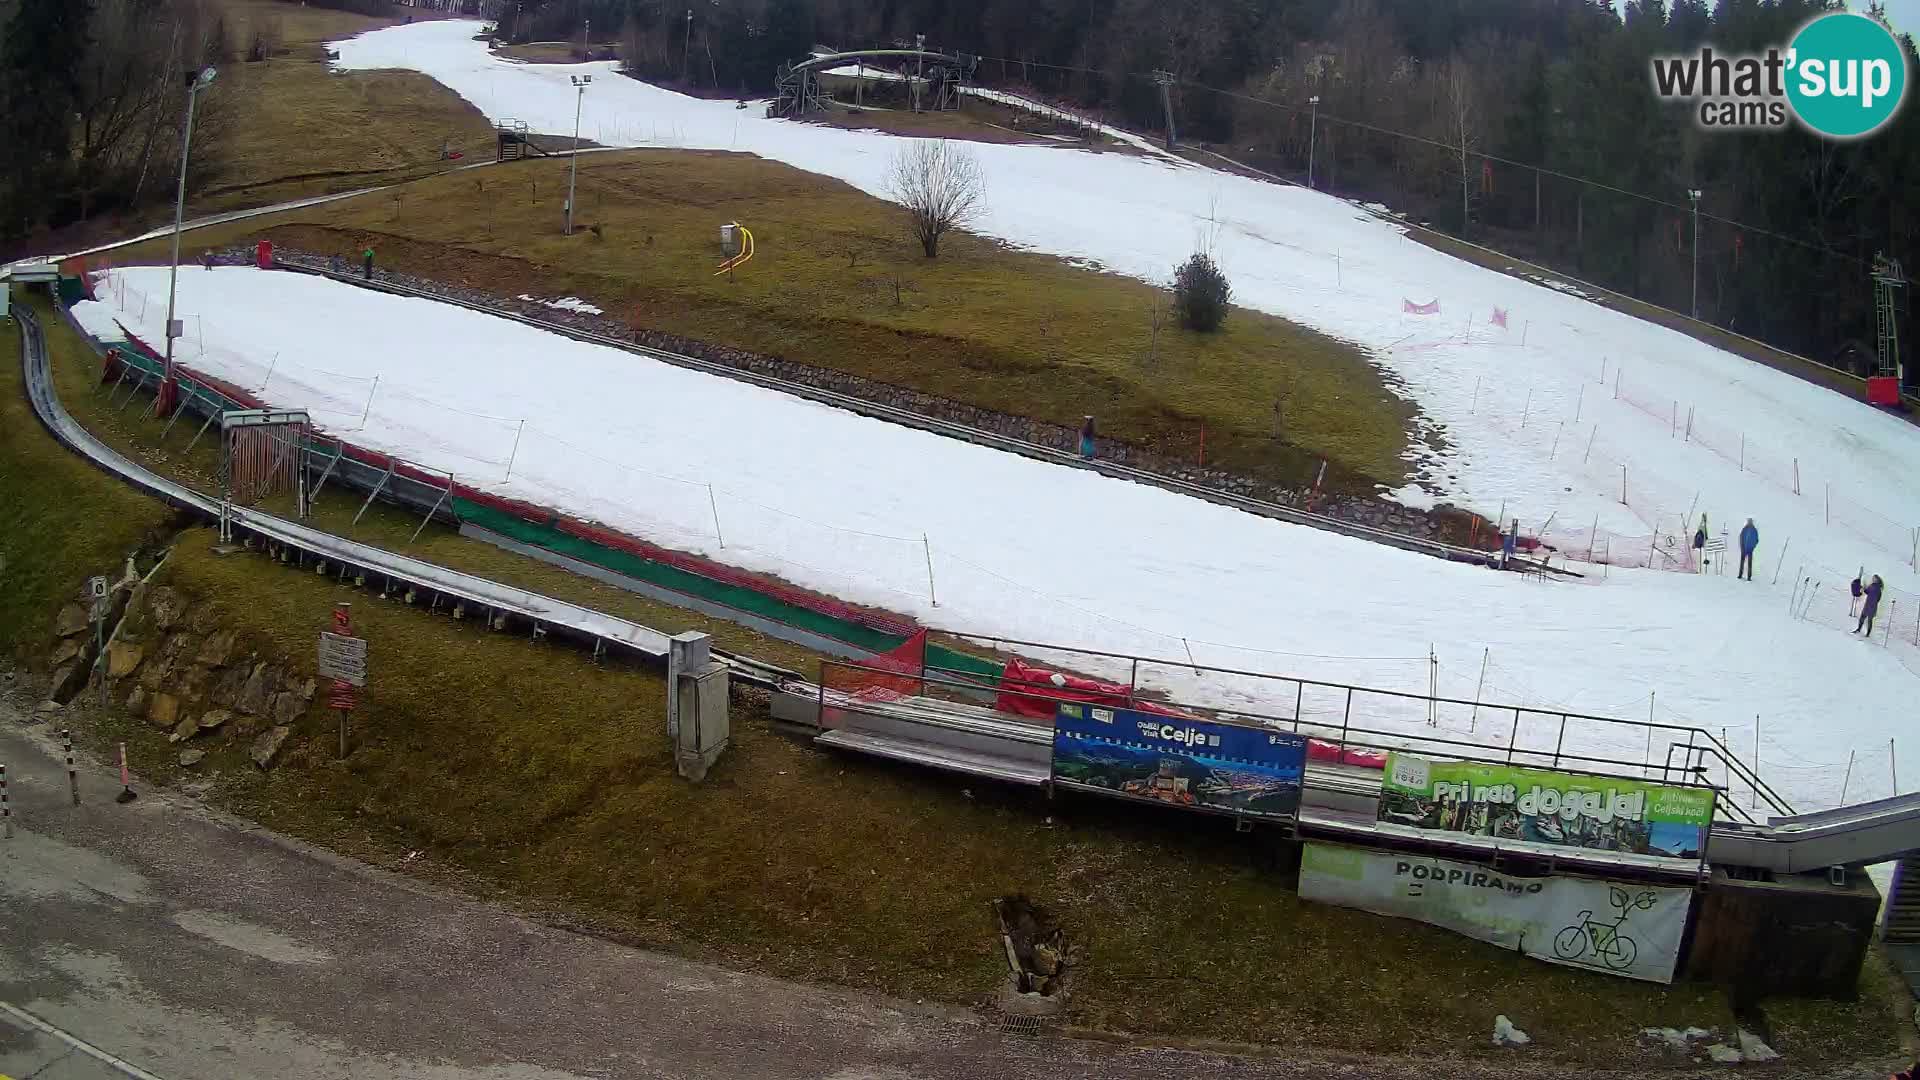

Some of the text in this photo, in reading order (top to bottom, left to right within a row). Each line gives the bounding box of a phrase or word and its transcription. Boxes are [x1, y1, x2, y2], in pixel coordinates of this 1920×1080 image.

[1160, 724, 1206, 747] Celje
[1432, 780, 1470, 803] Pri
[1472, 784, 1516, 803] nas
[1517, 785, 1645, 824] dogaja!
[1395, 861, 1544, 893] PODPIRAMO
